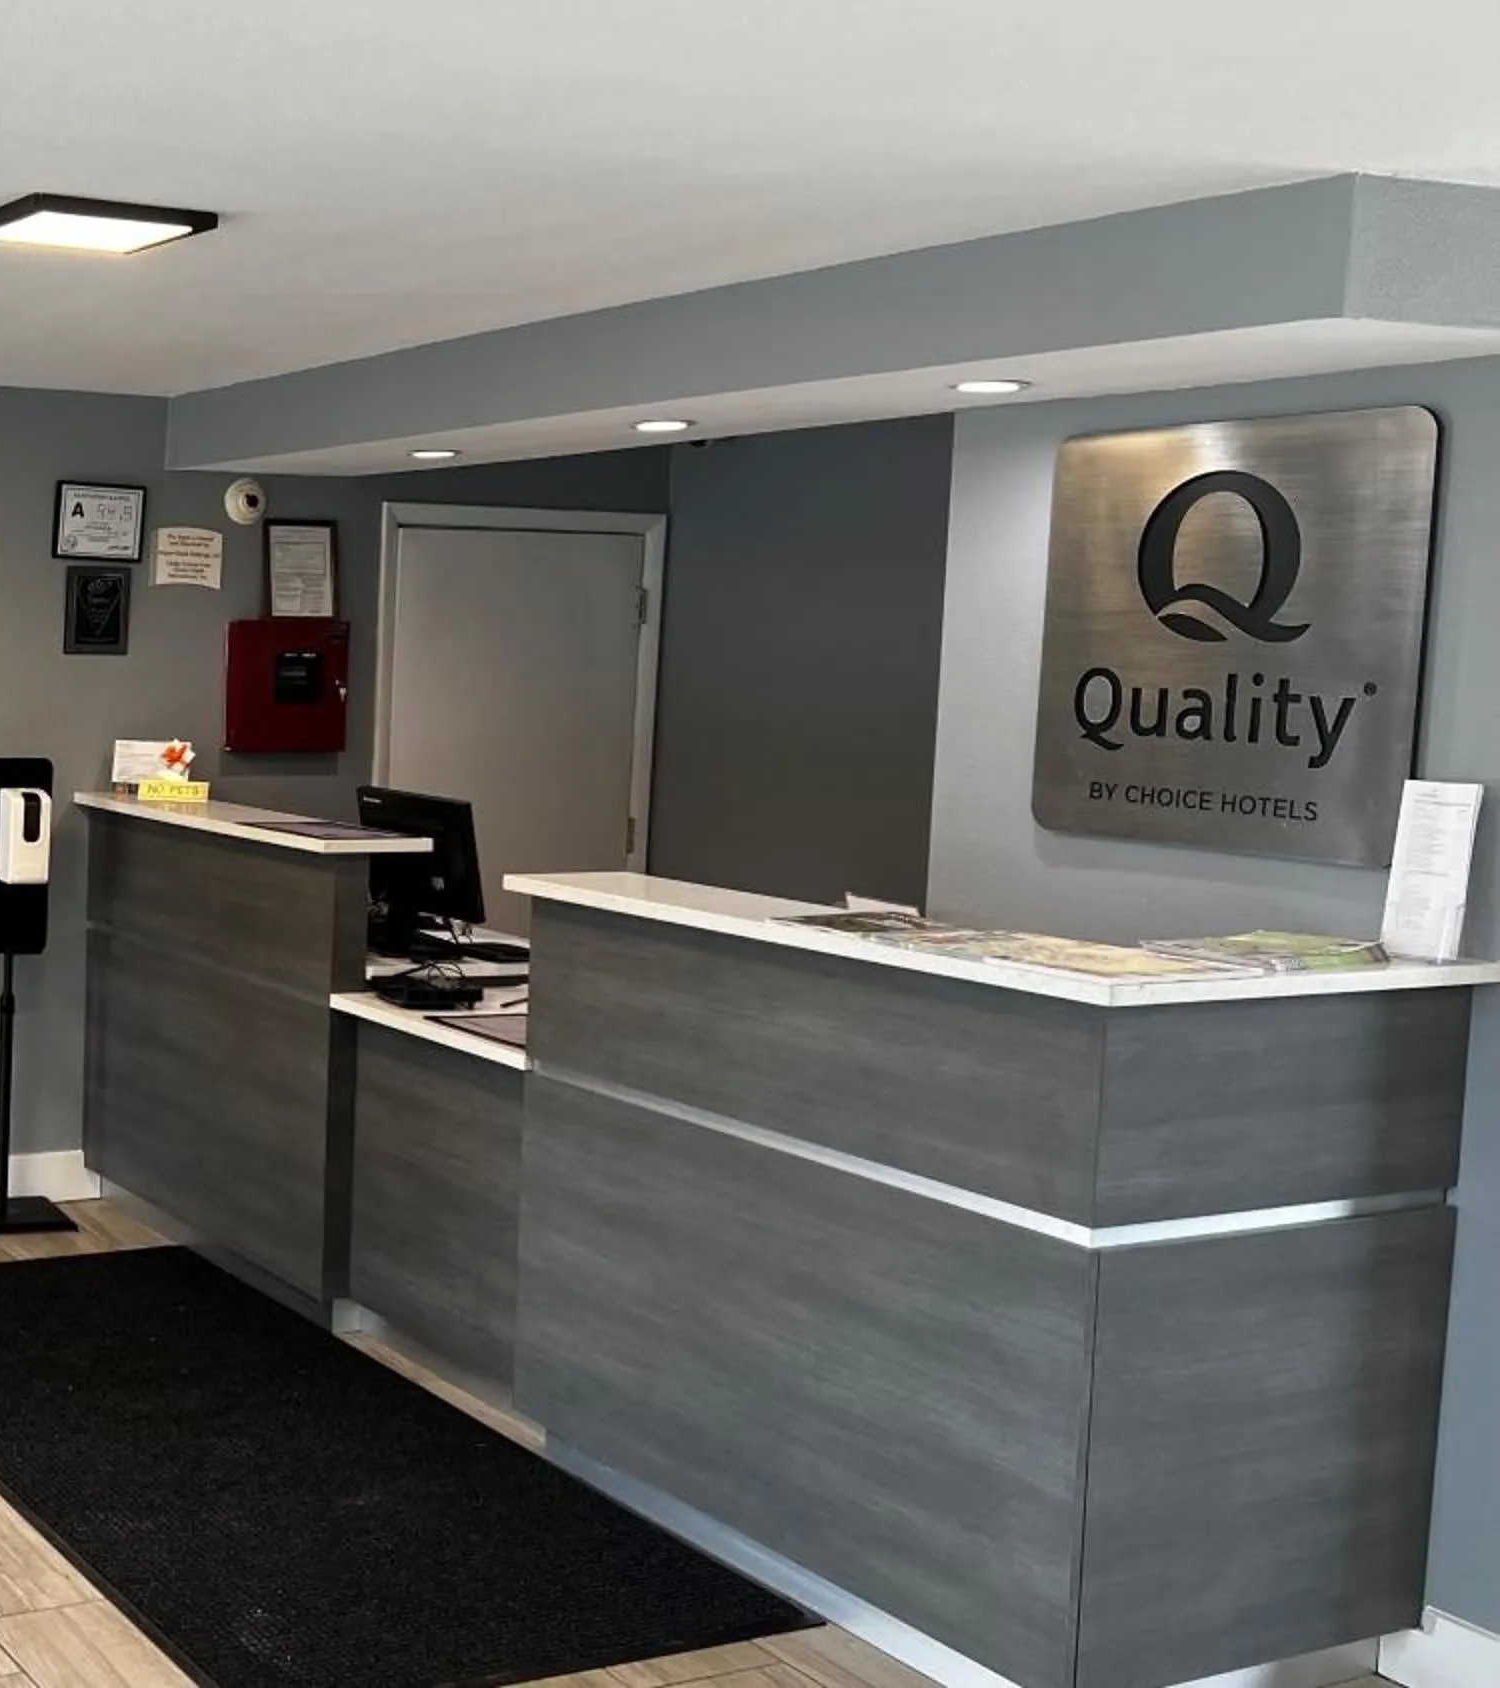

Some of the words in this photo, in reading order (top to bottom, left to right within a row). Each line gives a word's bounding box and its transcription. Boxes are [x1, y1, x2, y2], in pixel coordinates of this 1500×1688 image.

[71, 501, 85, 518] A
[1138, 469, 1312, 642] Q
[1073, 666, 1358, 769] Quality
[1088, 780, 1118, 801] BY
[1124, 784, 1214, 812] CHOICE
[1220, 792, 1319, 822] HOTELS
